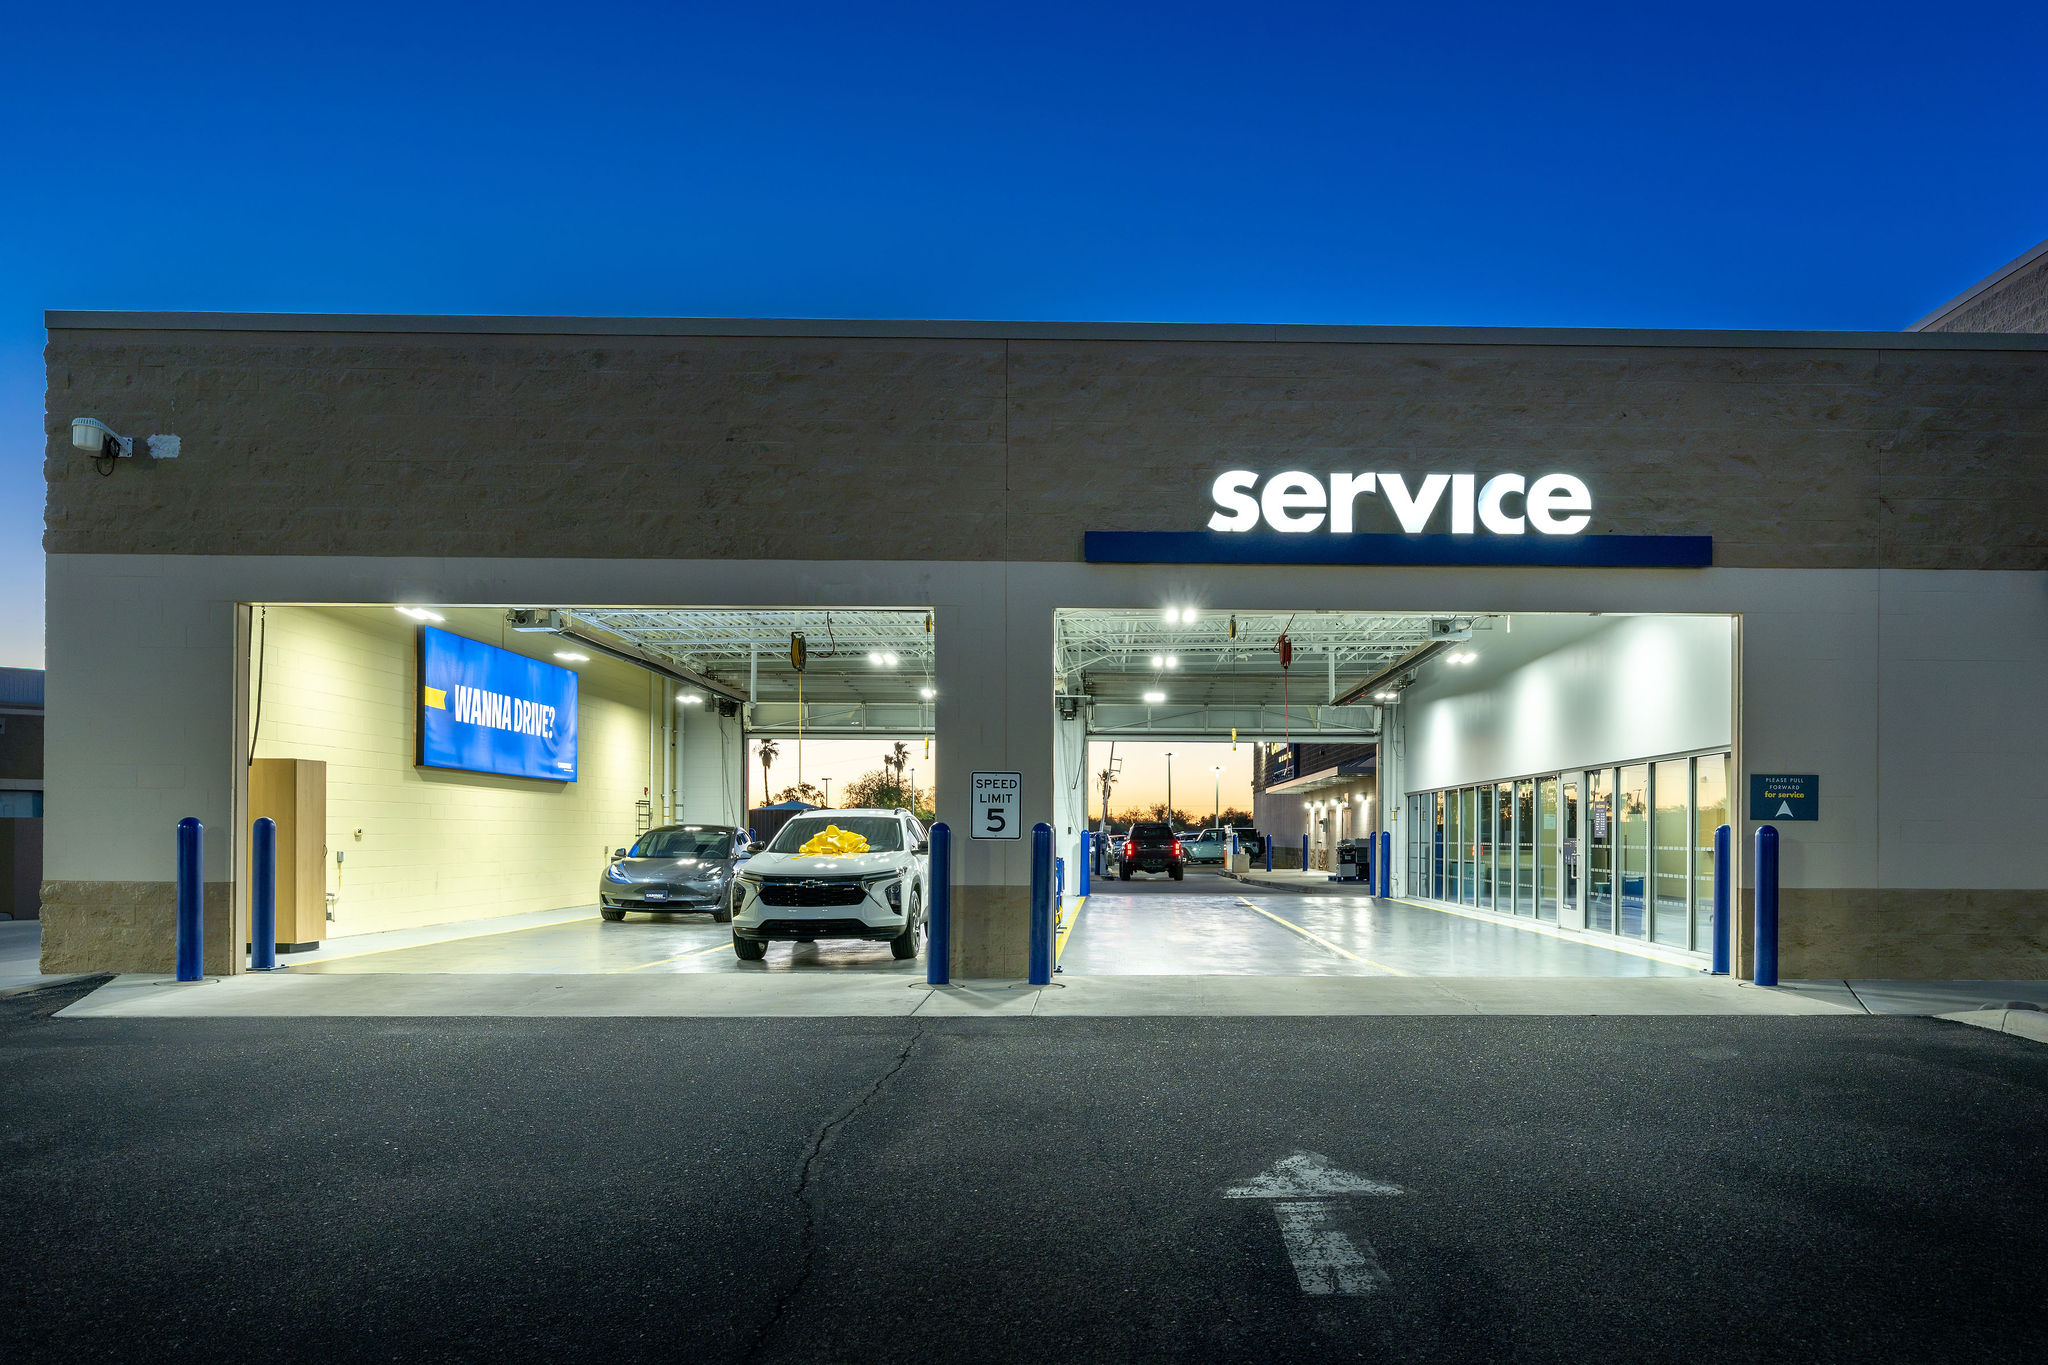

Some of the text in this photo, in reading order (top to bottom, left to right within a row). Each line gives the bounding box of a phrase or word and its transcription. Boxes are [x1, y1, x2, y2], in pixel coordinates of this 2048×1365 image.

[1207, 469, 1592, 535] service
[454, 684, 556, 739] WANNA DRIVE?
[976, 779, 1018, 789] SPEED
[980, 793, 1013, 803] LIMIT
[1764, 790, 1777, 798] for
[986, 808, 1006, 832] 5
